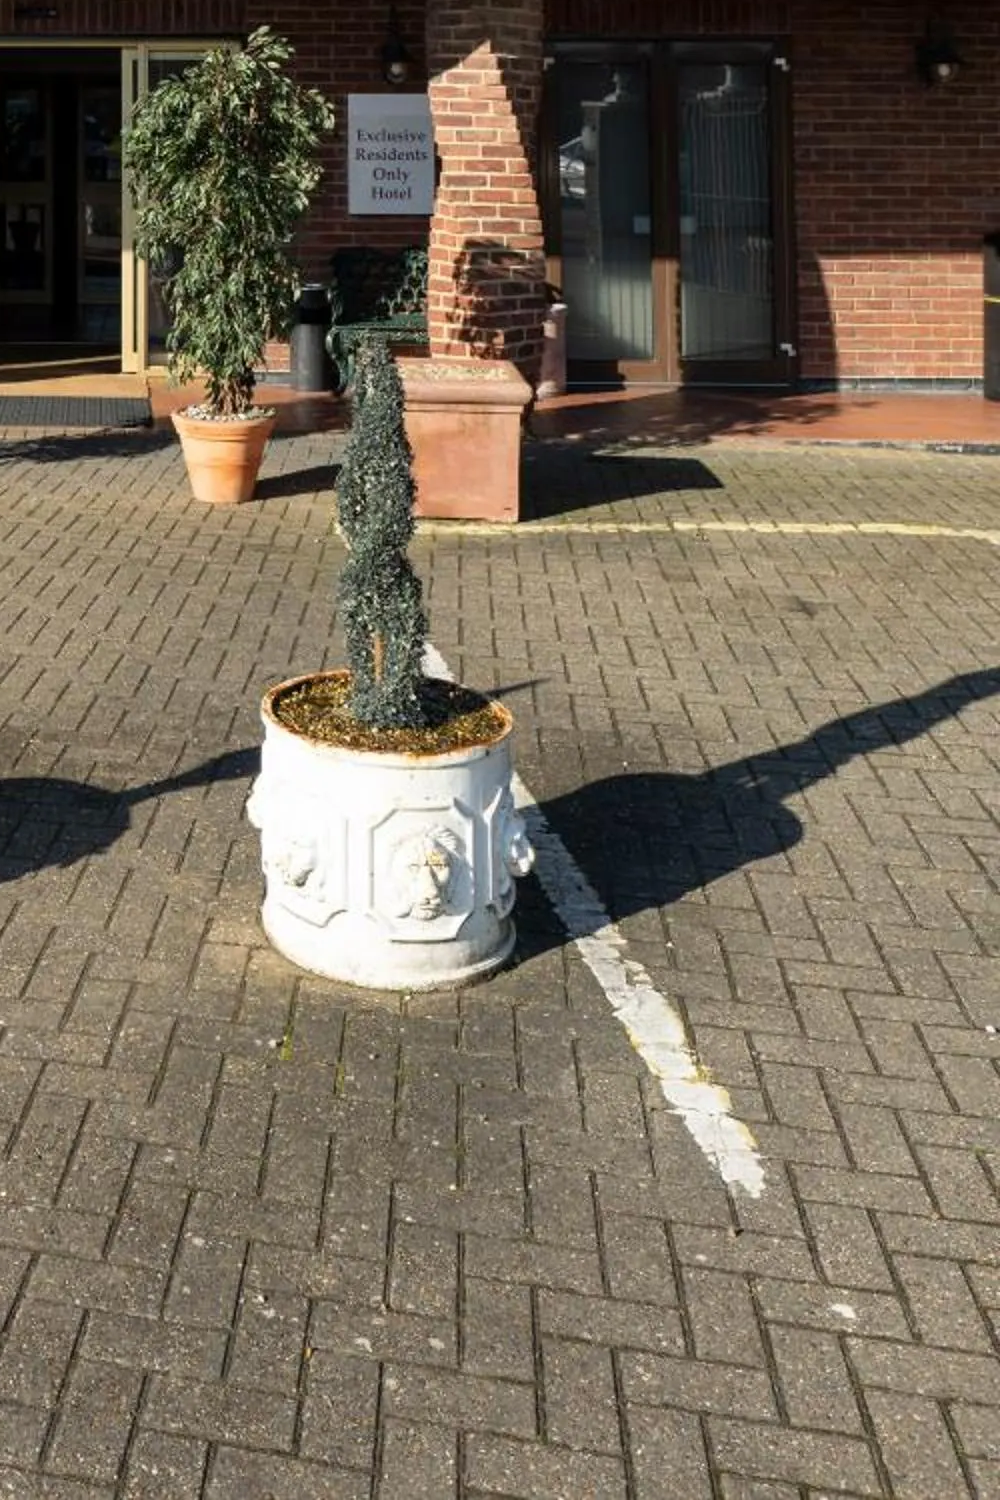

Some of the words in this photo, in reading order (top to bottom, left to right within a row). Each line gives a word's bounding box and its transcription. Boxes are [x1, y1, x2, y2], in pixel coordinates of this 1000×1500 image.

[356, 129, 427, 142] Exclusive
[355, 148, 428, 161] Residents
[373, 167, 409, 184] Only
[372, 186, 412, 199] Hotel
